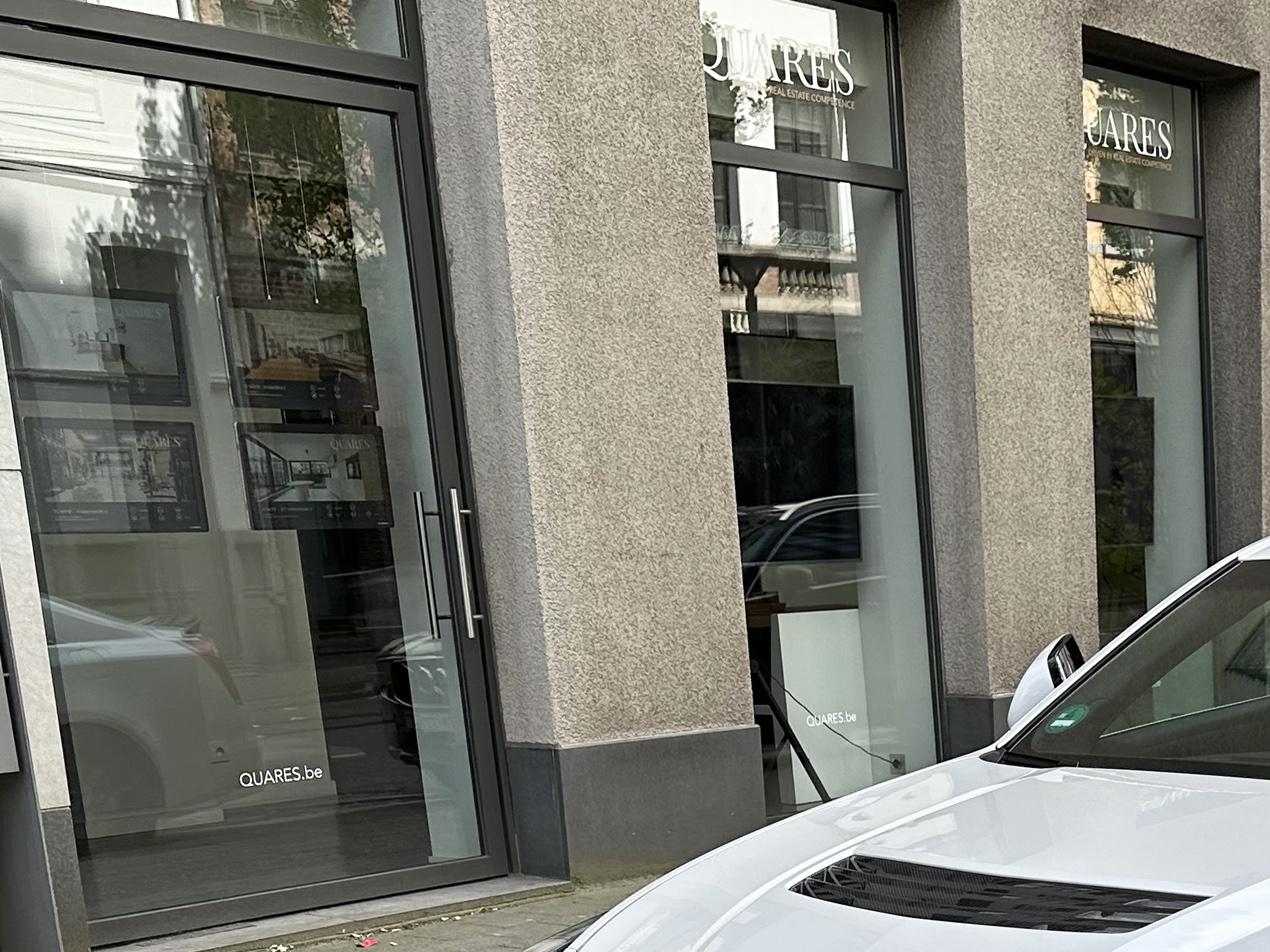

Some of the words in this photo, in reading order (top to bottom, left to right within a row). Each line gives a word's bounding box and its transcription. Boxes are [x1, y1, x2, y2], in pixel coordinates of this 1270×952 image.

[787, 88, 810, 101] ESTATE
[1083, 107, 1172, 160] UARES
[330, 437, 370, 450] QUARES
[240, 764, 323, 787] QUARES.be
